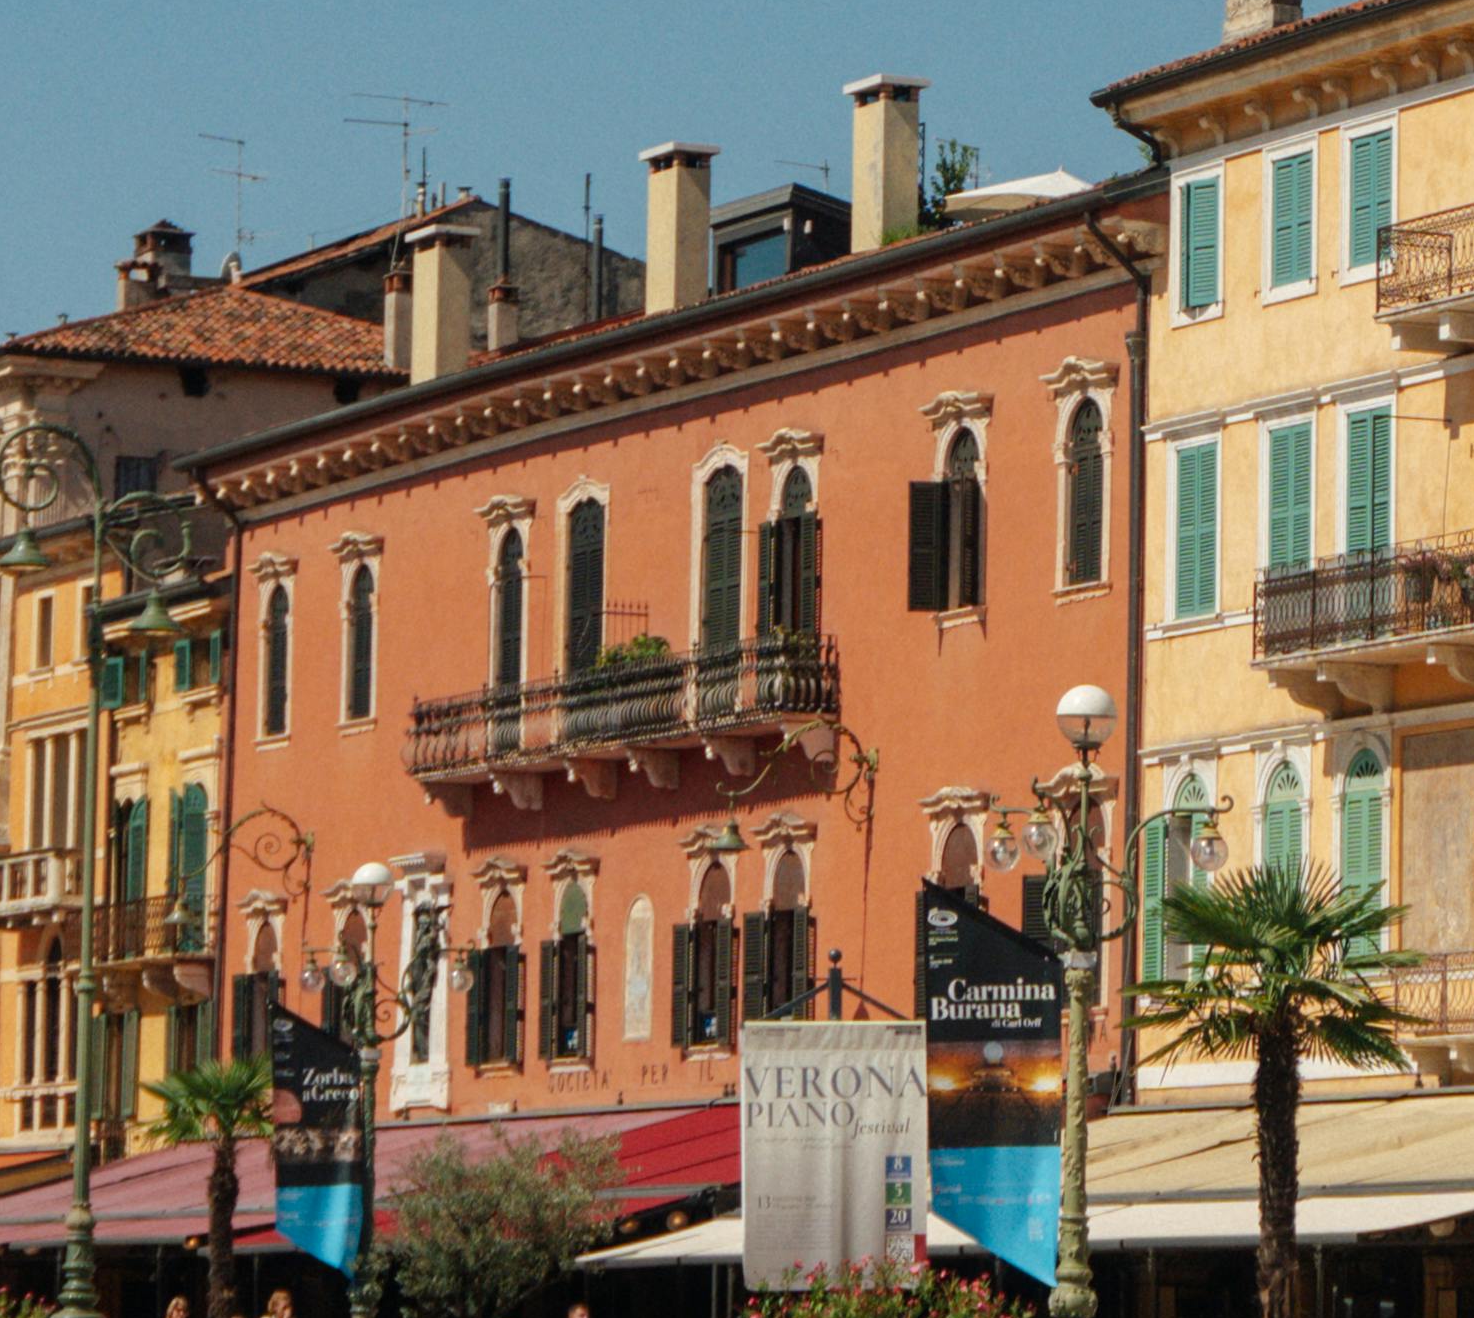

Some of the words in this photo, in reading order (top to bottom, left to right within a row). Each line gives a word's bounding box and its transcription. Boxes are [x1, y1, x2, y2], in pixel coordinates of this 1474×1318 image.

[947, 977, 1056, 1002] Carmina
[931, 997, 1022, 1021] Burana
[1002, 1018, 1022, 1028] Carl
[1023, 1017, 1042, 1028] Orff
[744, 1064, 927, 1100] VERONA
[746, 1100, 856, 1129] PIANO
[852, 1117, 912, 1140] festival
[894, 1156, 903, 1171] 8
[890, 1209, 907, 1224] 20
